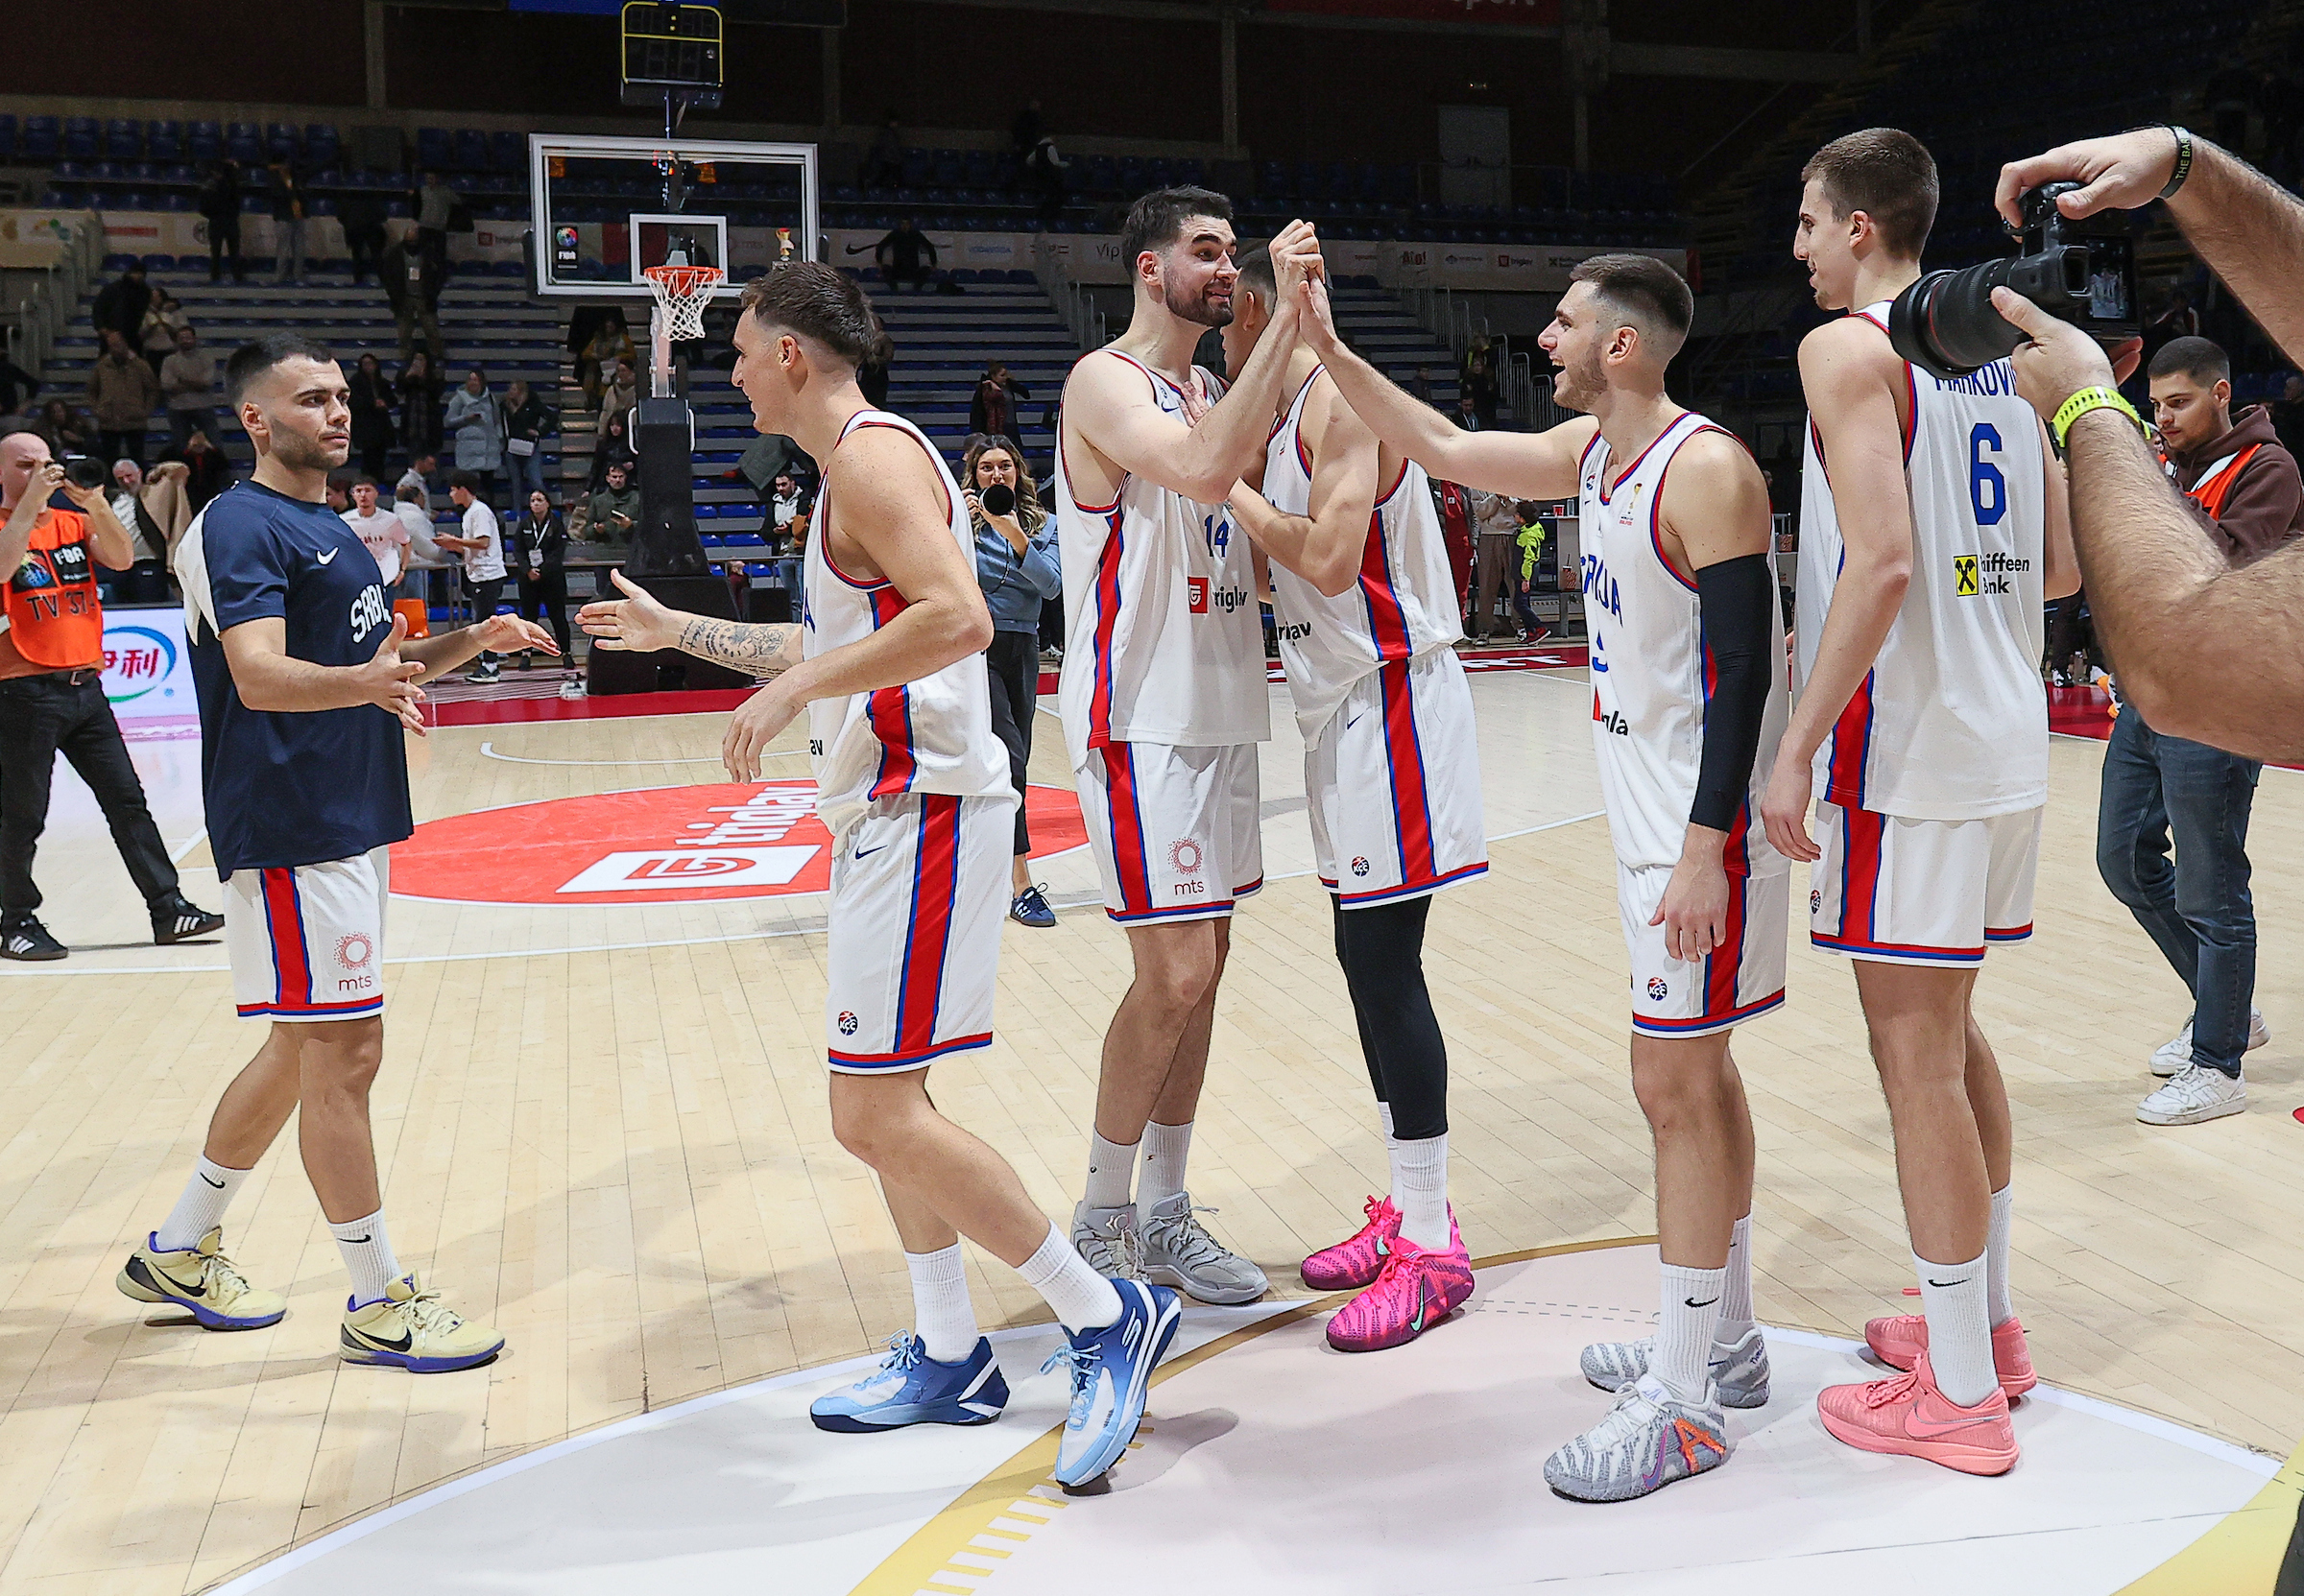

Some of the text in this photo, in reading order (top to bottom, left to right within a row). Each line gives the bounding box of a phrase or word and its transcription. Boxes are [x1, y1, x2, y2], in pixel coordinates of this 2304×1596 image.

[2174, 158, 2190, 179] THE
[1969, 422, 2006, 525] 6
[1204, 514, 1229, 558] 14
[26, 594, 60, 621] TV
[1174, 879, 1205, 896] mts
[338, 975, 372, 991] mts
